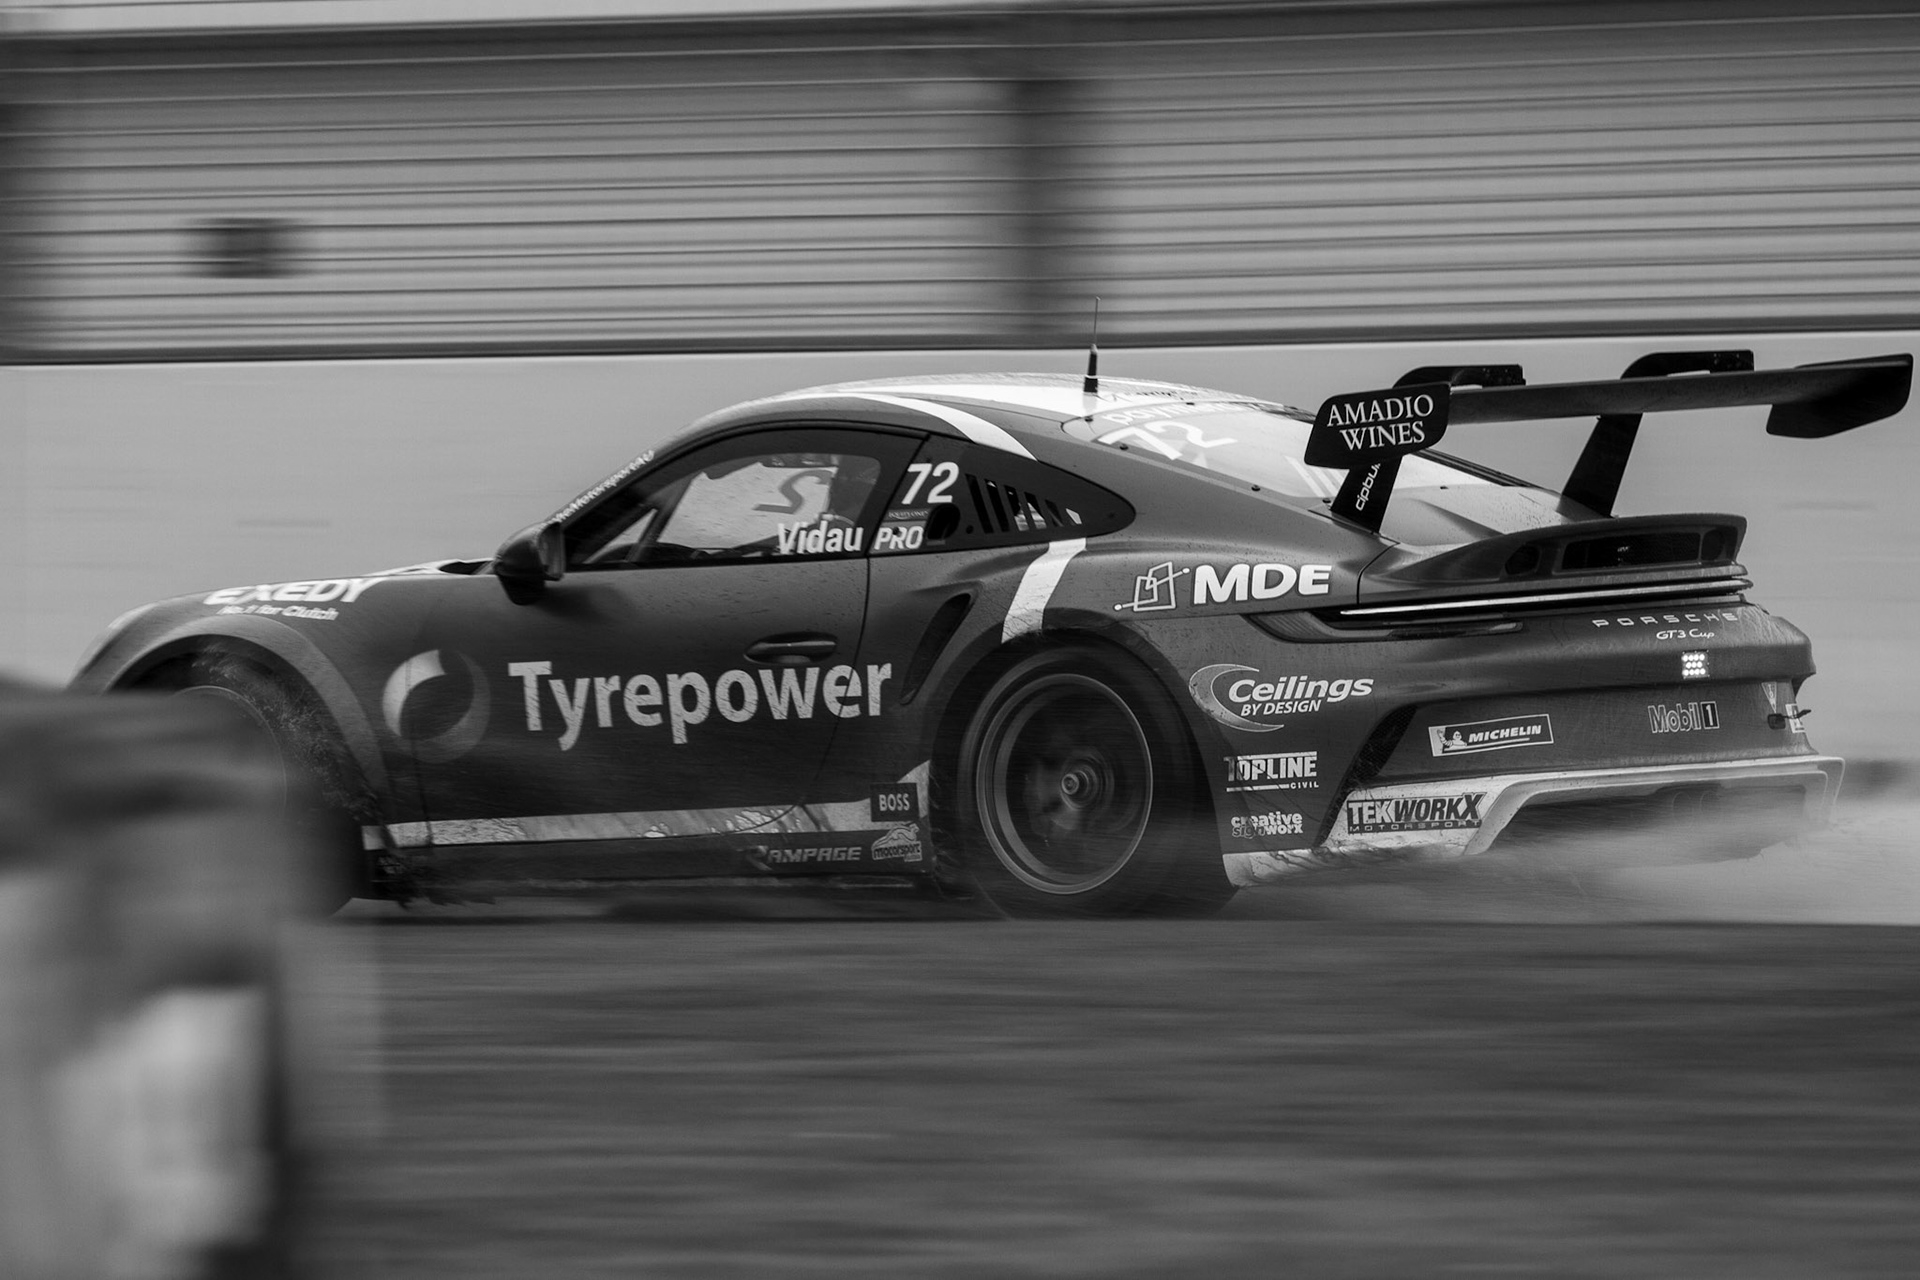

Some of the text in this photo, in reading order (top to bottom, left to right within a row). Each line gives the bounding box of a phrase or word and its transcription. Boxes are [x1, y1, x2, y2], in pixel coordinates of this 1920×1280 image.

[1327, 394, 1434, 427] AMADIO
[1099, 420, 1238, 460] 72
[1340, 421, 1425, 451] WINES
[901, 461, 959, 505] 72
[1355, 463, 1380, 510] cipbu
[778, 520, 864, 555] Vidau
[874, 526, 924, 550] PRO
[203, 580, 381, 605] EXEDY
[1193, 563, 1332, 605] MDE
[1592, 612, 1738, 627] PORSCHE
[1656, 628, 1715, 640] GT3 Cup
[1228, 675, 1374, 703] Ceilings
[508, 660, 892, 751] Tyrepower
[1240, 700, 1321, 717] BY DESIGN
[1647, 702, 1701, 734] Mobil
[1468, 725, 1541, 743] MICHELIN
[1224, 752, 1317, 781] TOPLINE
[1290, 781, 1319, 789] CIVIL
[878, 793, 910, 812] BOSS
[1230, 811, 1303, 827] creative
[1349, 821, 1479, 832] MOTORSPORT
